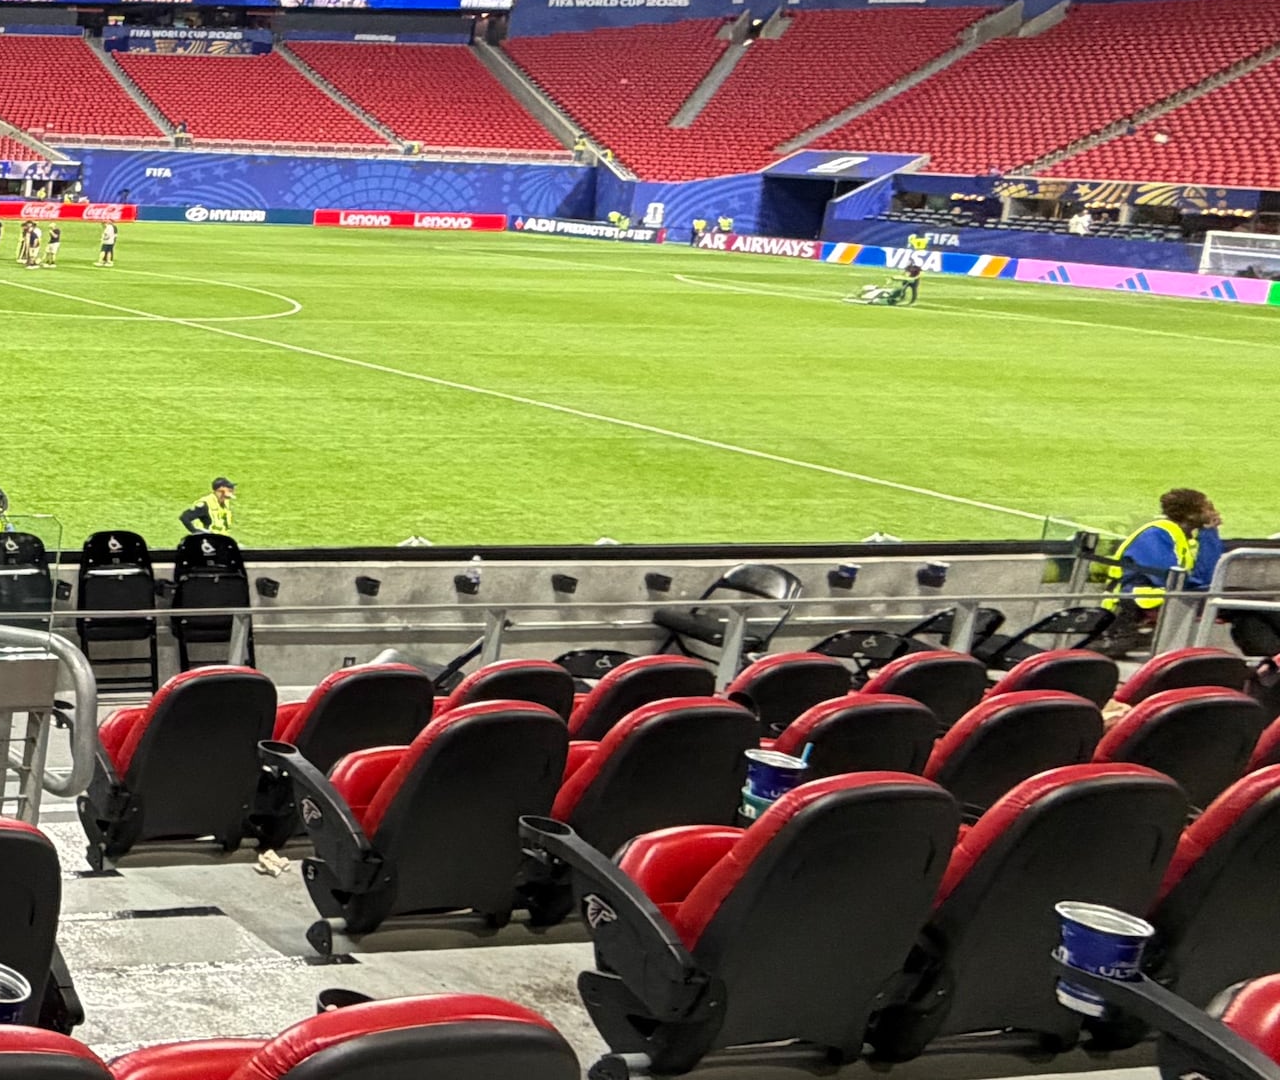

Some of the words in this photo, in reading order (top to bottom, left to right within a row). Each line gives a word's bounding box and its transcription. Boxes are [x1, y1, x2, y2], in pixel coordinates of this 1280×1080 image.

[129, 29, 151, 38] FIFA
[187, 30, 208, 39] CUP
[145, 167, 172, 178] FIFA
[209, 209, 266, 222] HYUNDAI
[339, 211, 392, 227] Lenovo
[413, 213, 473, 229] Lenovo
[523, 218, 556, 232] ADI
[731, 235, 816, 258] AIRWAYS
[924, 232, 960, 247] FIFA
[881, 246, 943, 272] VISA
